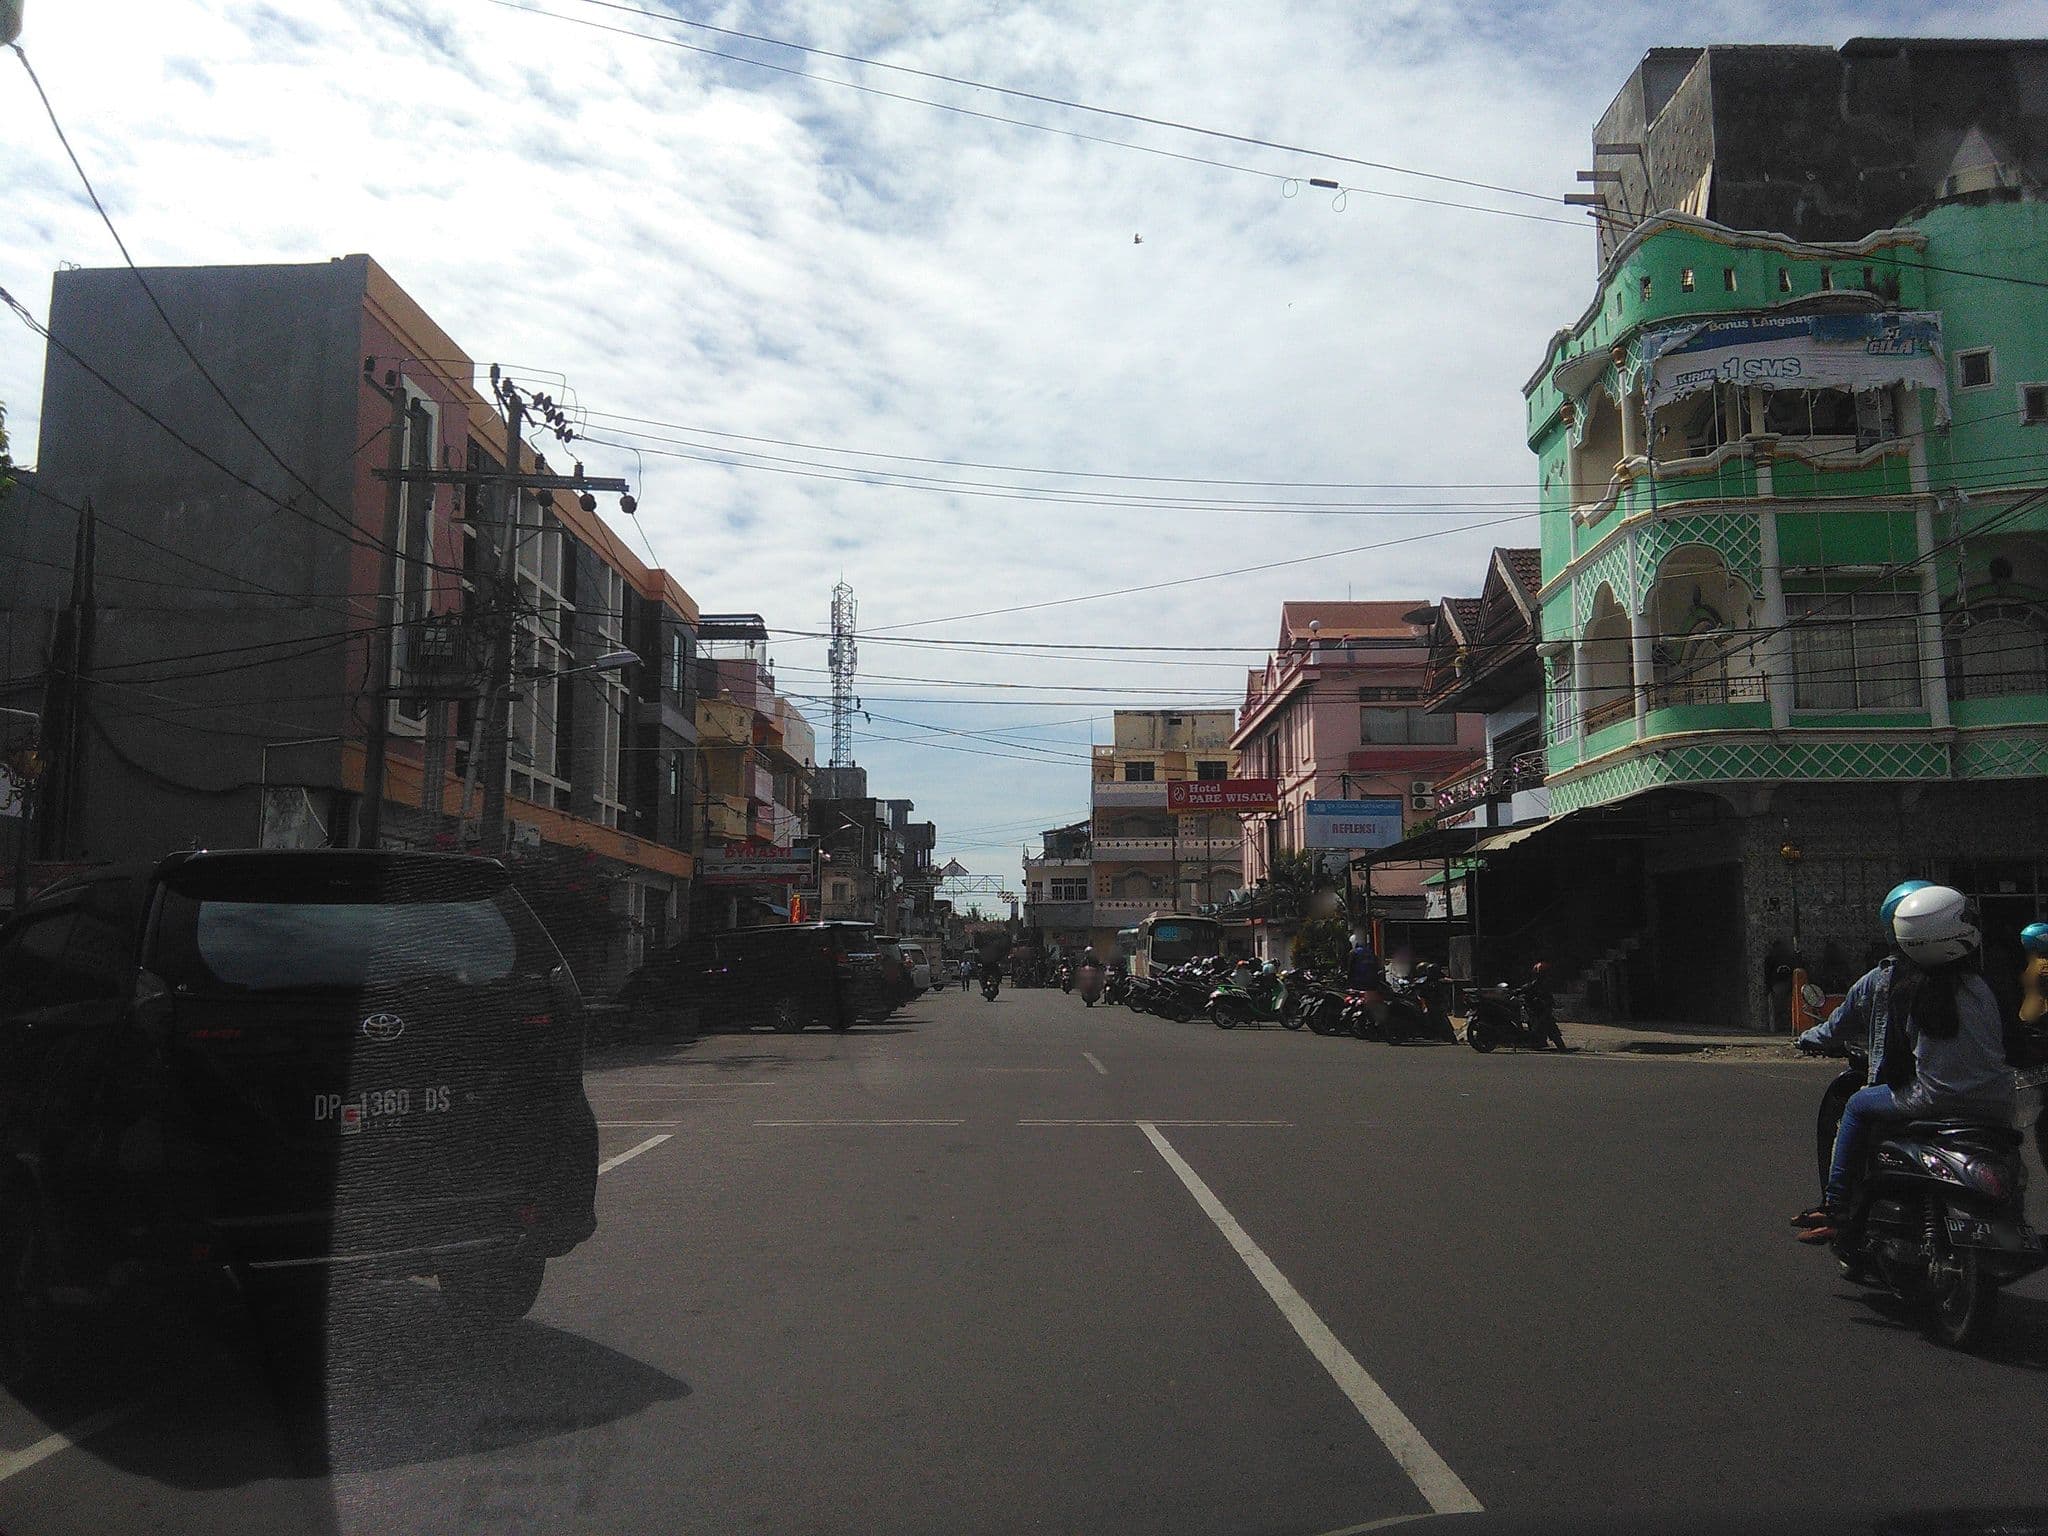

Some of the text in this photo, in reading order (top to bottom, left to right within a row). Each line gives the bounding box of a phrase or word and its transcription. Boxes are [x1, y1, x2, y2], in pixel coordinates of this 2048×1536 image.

[1709, 318, 1748, 331] Bonus
[1676, 357, 1801, 386] KIRIM 1 SMS
[1189, 784, 1220, 792] Hotel
[1189, 793, 1275, 804] PARE WISATA
[1332, 823, 1376, 834] REFLEKSI
[314, 1094, 341, 1121] DP
[425, 1085, 450, 1113] DS
